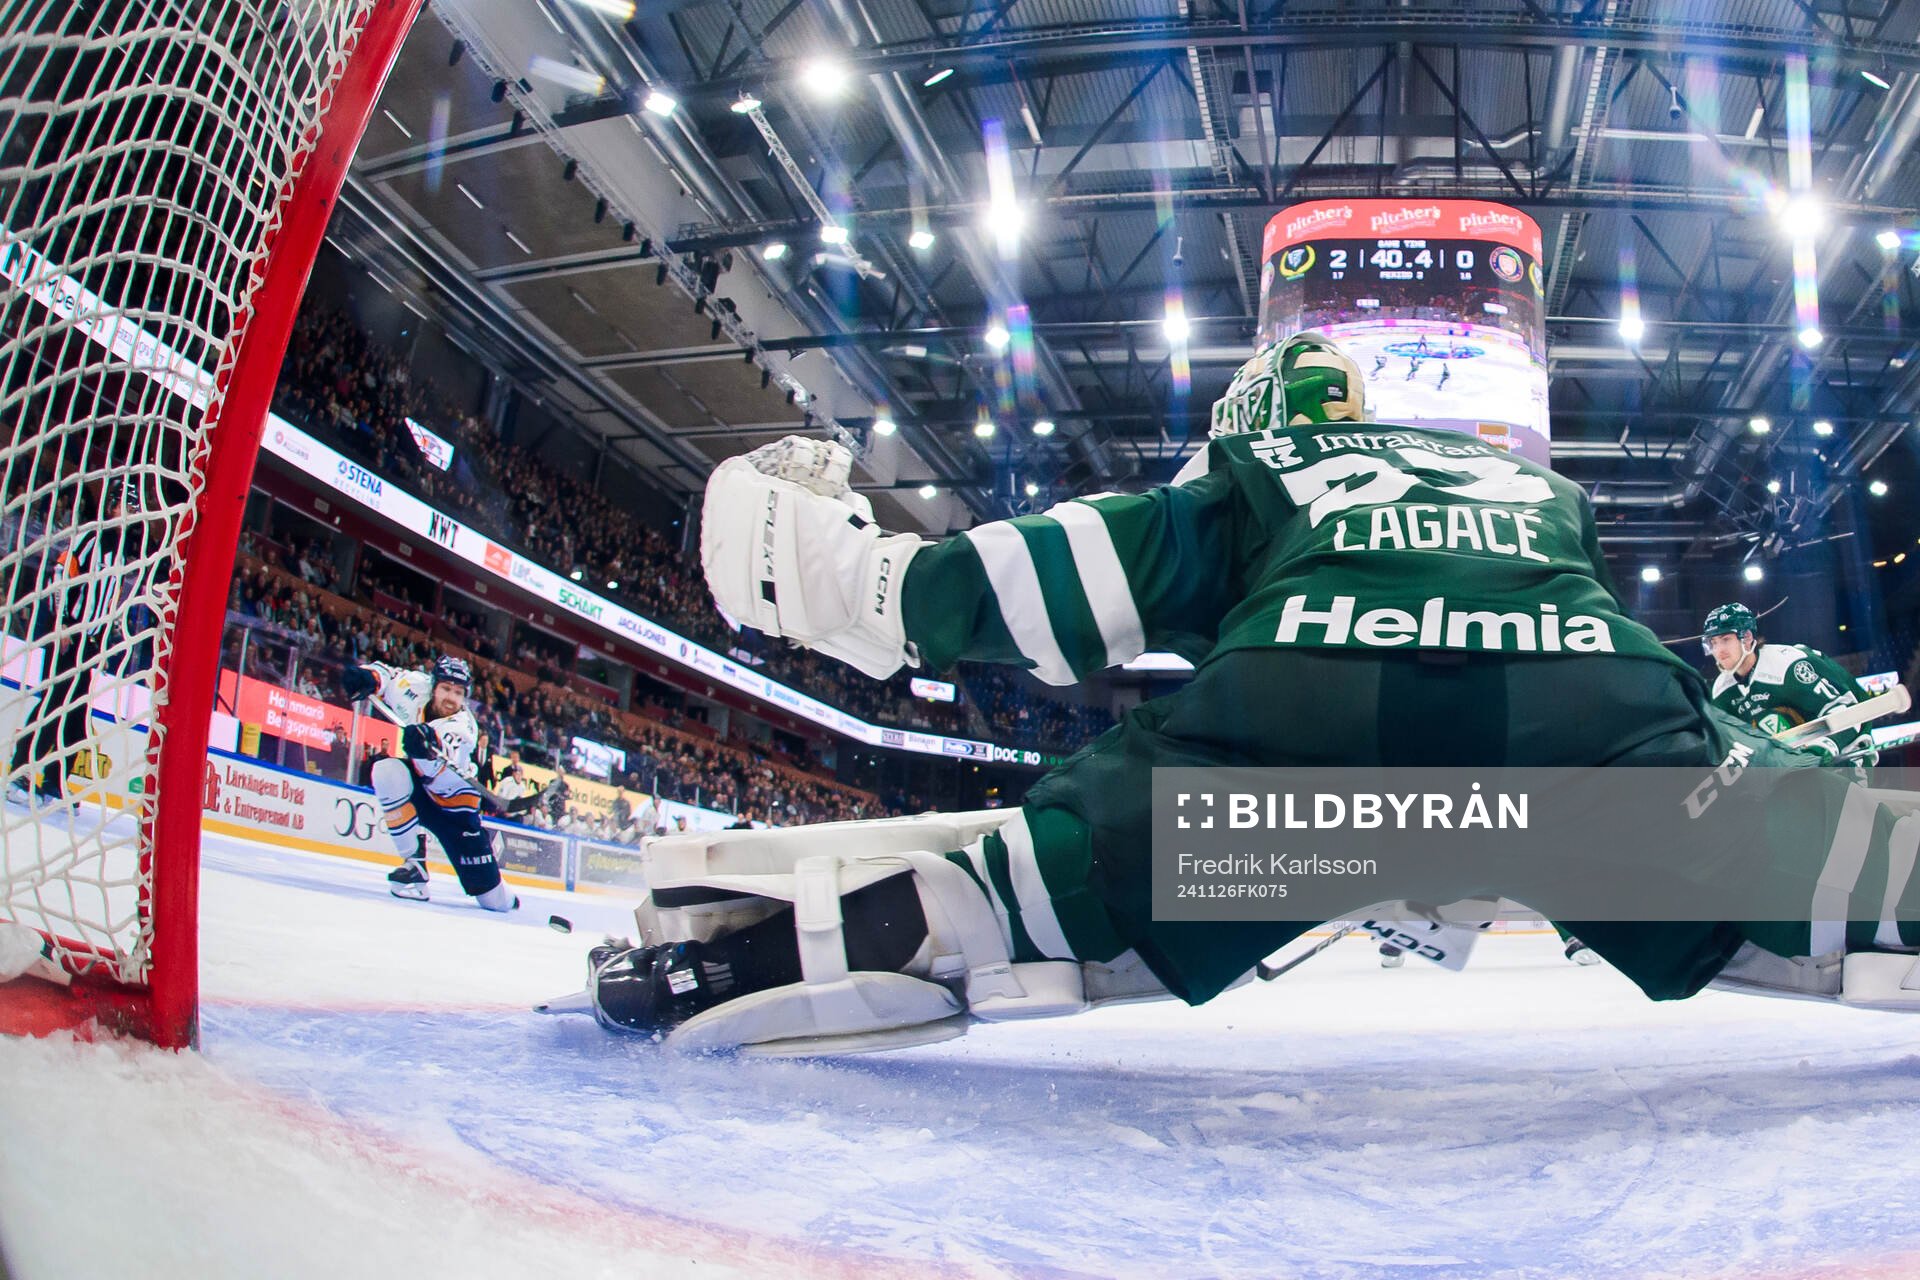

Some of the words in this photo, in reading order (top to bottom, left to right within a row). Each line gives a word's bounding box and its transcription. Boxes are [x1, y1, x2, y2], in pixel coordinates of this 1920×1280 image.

[1286, 205, 1353, 239] pitcher's
[1370, 206, 1441, 231] pitcher's
[1459, 210, 1523, 232] pitcher's
[1329, 249, 1347, 268] 2
[1370, 249, 1433, 268] 40.4
[1456, 250, 1474, 269] 0
[347, 465, 383, 497] STENA
[1333, 505, 1550, 563] LAGACÉ
[874, 557, 891, 616] CCM
[1274, 594, 1617, 653] Helmia
[1680, 741, 1754, 819] CCM
[224, 797, 231, 814] &
[292, 813, 304, 830] AB
[1362, 919, 1446, 962] CCM
